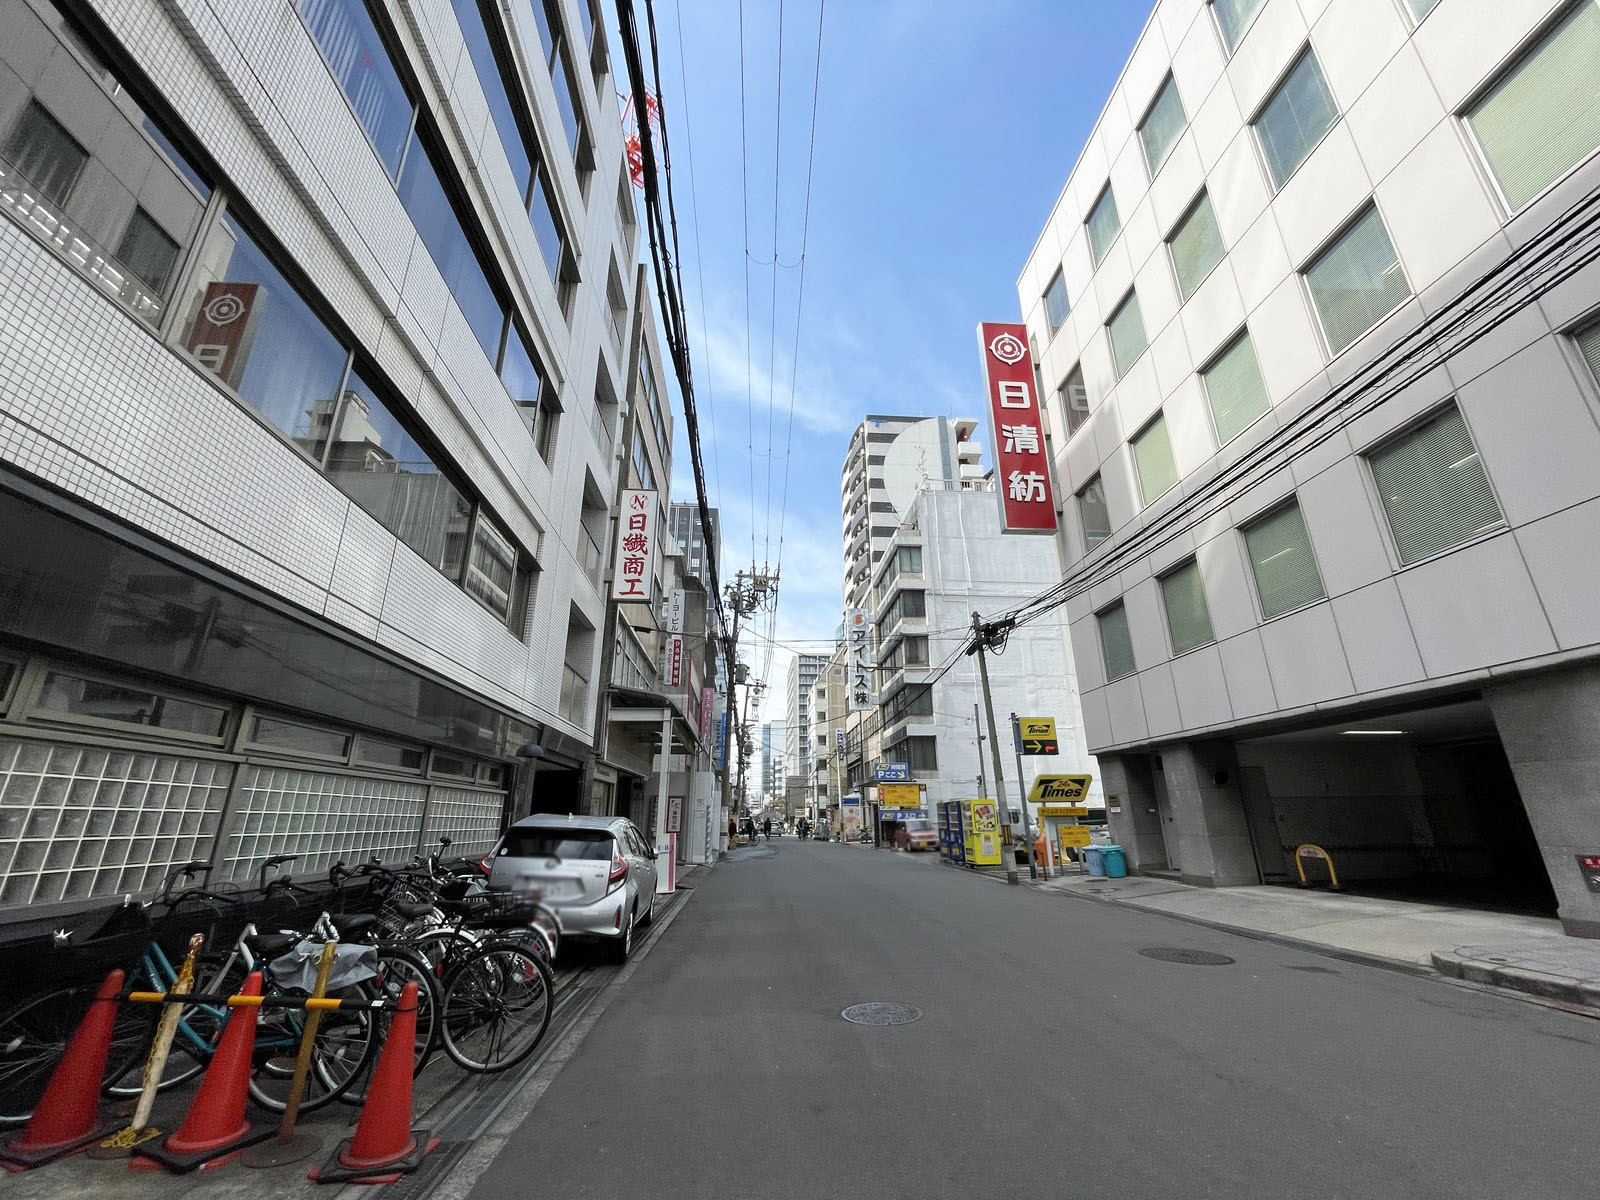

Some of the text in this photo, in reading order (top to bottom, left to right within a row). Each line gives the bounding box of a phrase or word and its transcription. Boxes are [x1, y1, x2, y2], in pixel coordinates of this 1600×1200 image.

[998, 380, 1046, 502] 日清紡
[671, 591, 681, 632] トーヨービル
[852, 630, 868, 705] アイトス株
[1039, 783, 1083, 799] Times
